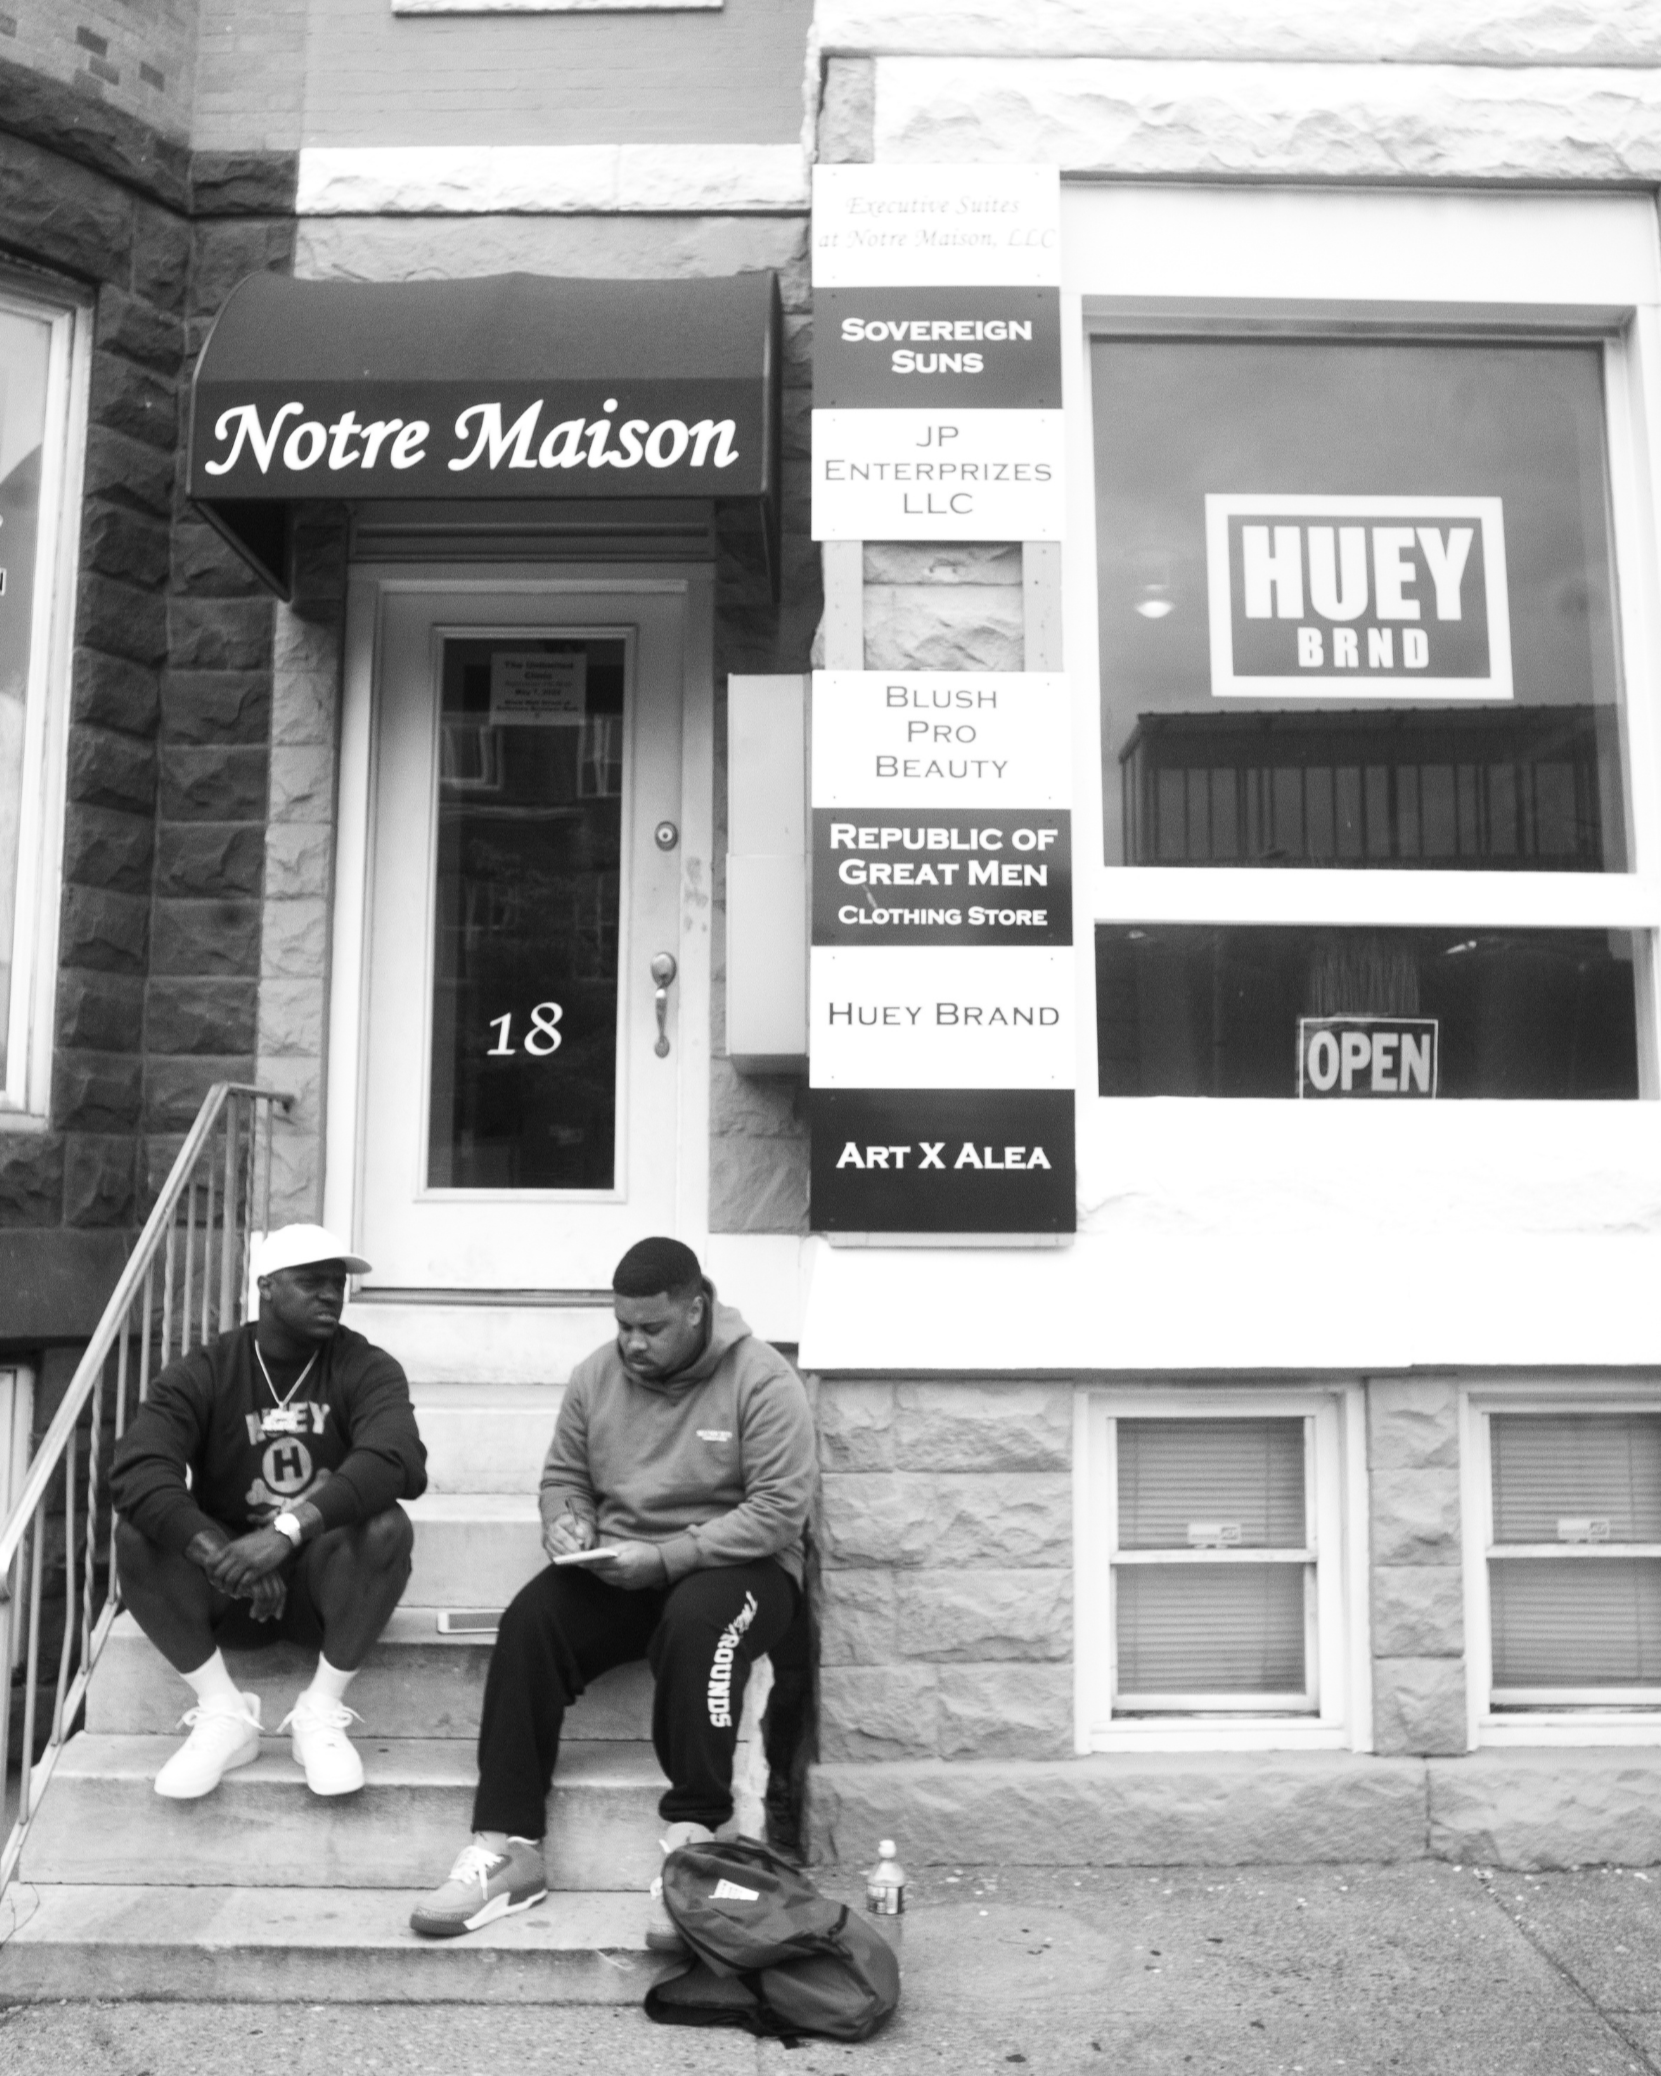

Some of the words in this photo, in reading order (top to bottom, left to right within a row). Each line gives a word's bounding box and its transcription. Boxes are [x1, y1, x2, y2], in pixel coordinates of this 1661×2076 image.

[845, 196, 950, 217] Executive
[955, 195, 1020, 215] Suites
[818, 233, 840, 248] at
[846, 229, 907, 249] Notre
[1007, 228, 1056, 249] LLC
[842, 318, 1031, 341] SOVEREIGN
[892, 350, 983, 373] SUNS
[205, 402, 429, 475] Notre
[448, 399, 739, 471] Maison
[917, 427, 958, 446] JP
[826, 460, 1051, 481] ENTERPRIZES
[904, 493, 972, 514] LLC
[1242, 525, 1474, 621] HUEY
[1298, 628, 1428, 667] BRND
[887, 686, 996, 708] BLUSH
[908, 721, 976, 743] PRO
[877, 756, 1007, 778] BEAUTY
[831, 824, 1002, 850] REPUBLIC
[1012, 829, 1058, 850] OF
[839, 859, 959, 885] GREAT
[969, 861, 1046, 885] MEN
[839, 905, 961, 925] CLOTHING
[969, 907, 1047, 925] STORE
[830, 1003, 921, 1025] HUEY
[937, 1003, 1059, 1025] BRAND
[488, 1002, 562, 1055] 18
[1309, 1032, 1428, 1090] OPEN
[836, 1142, 911, 1168] ART
[919, 1143, 945, 1168] X
[954, 1143, 1051, 1169] ALEA
[273, 1445, 303, 1483] H
